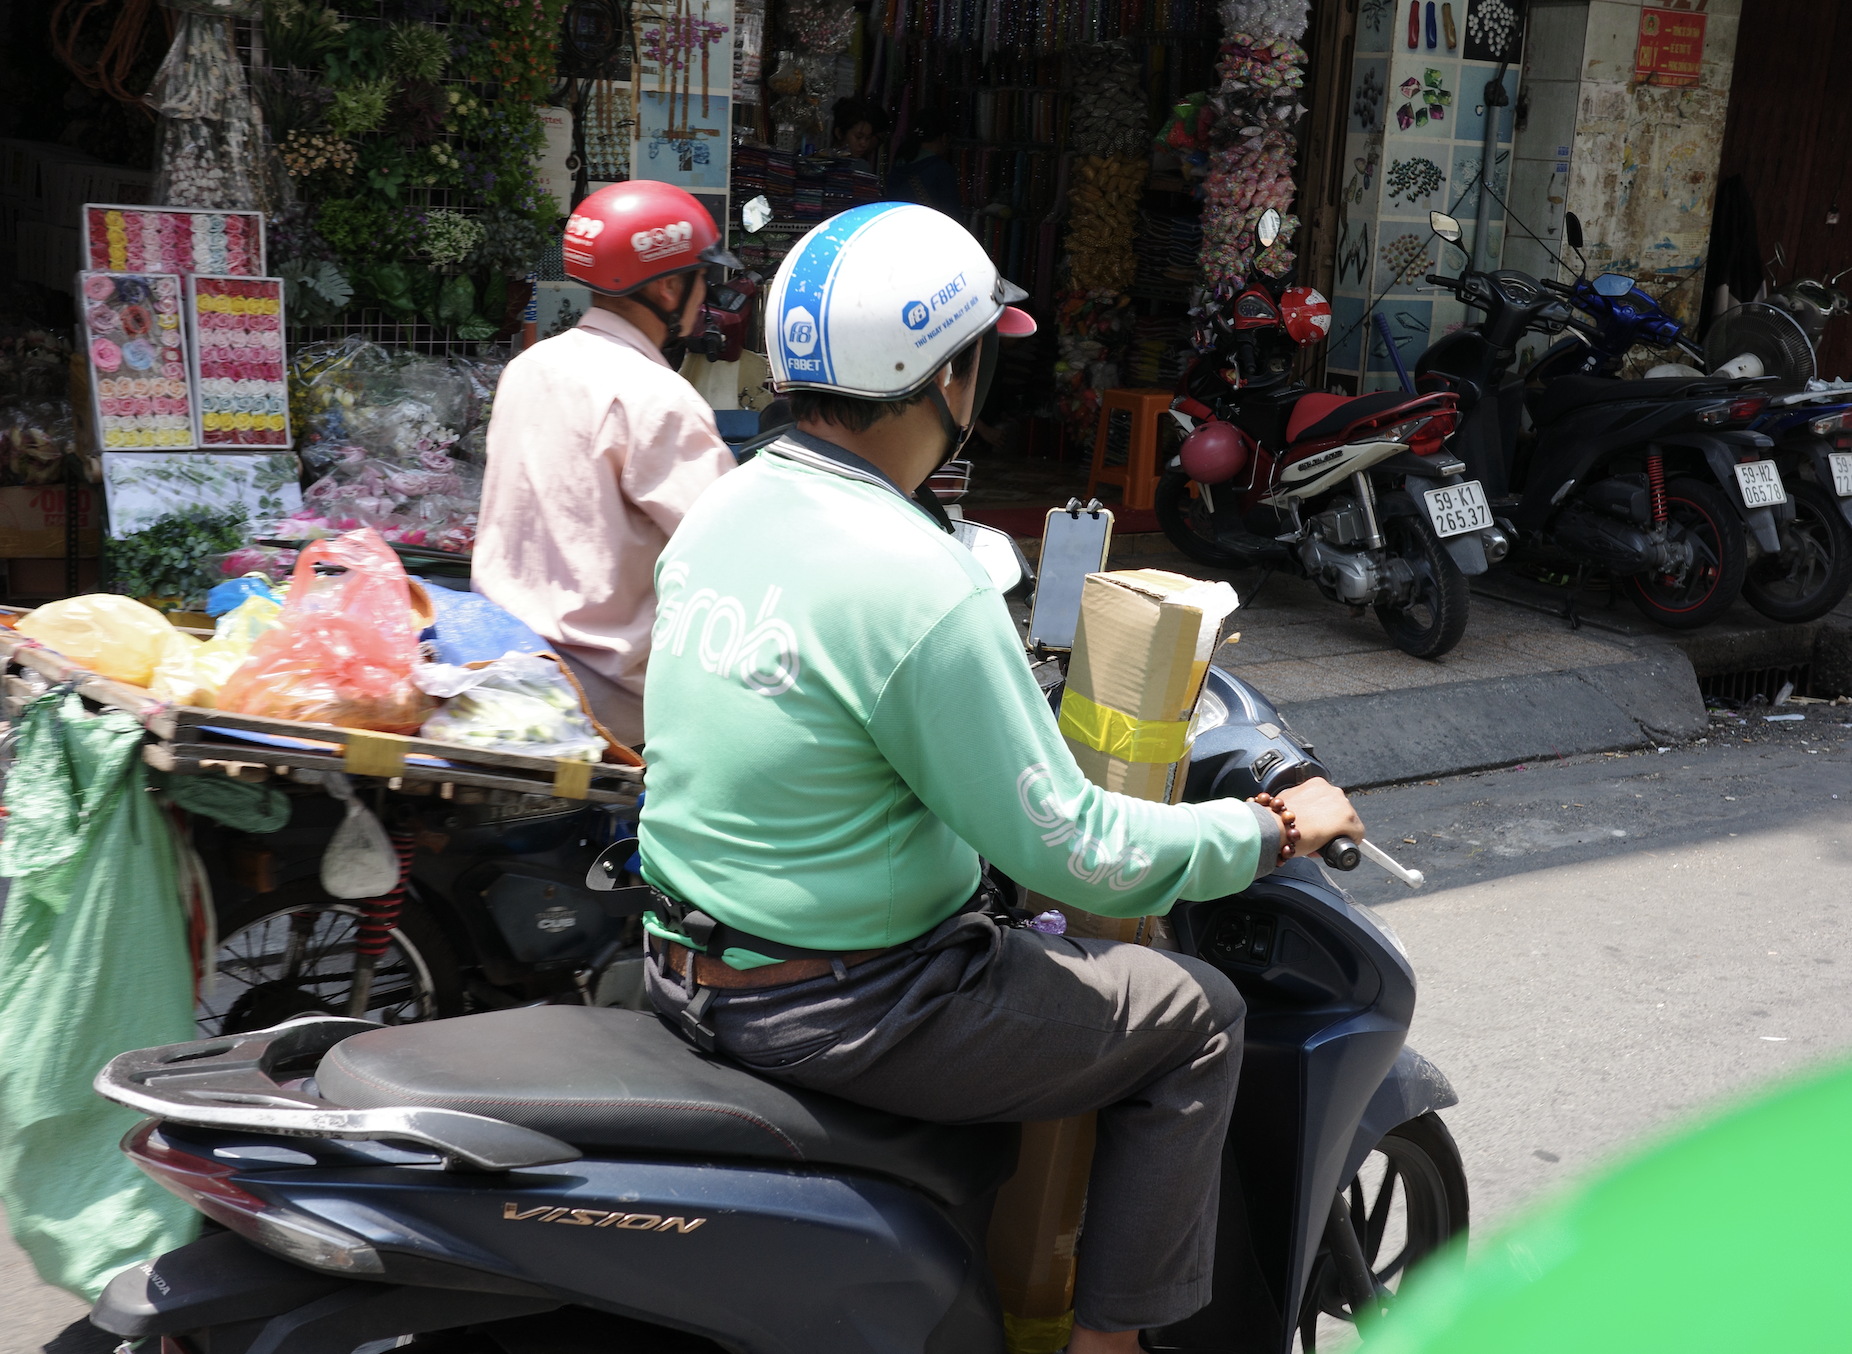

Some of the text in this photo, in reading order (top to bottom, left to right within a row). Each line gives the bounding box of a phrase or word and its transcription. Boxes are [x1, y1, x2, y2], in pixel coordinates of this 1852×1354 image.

[930, 271, 967, 312] F8BET
[927, 325, 943, 341] NGAY
[788, 358, 821, 371] F8BET
[1741, 465, 1773, 484] 59-H2
[1836, 456, 1852, 473] 59-
[1745, 484, 1781, 503] 065.78
[1836, 475, 1852, 492] 72
[1434, 486, 1475, 511] 59-K1
[1436, 505, 1485, 533] 265.37
[651, 560, 800, 697] Grab
[1017, 762, 1153, 891] Grab
[503, 1202, 707, 1234] VISION
[139, 1264, 171, 1296] HONDA
